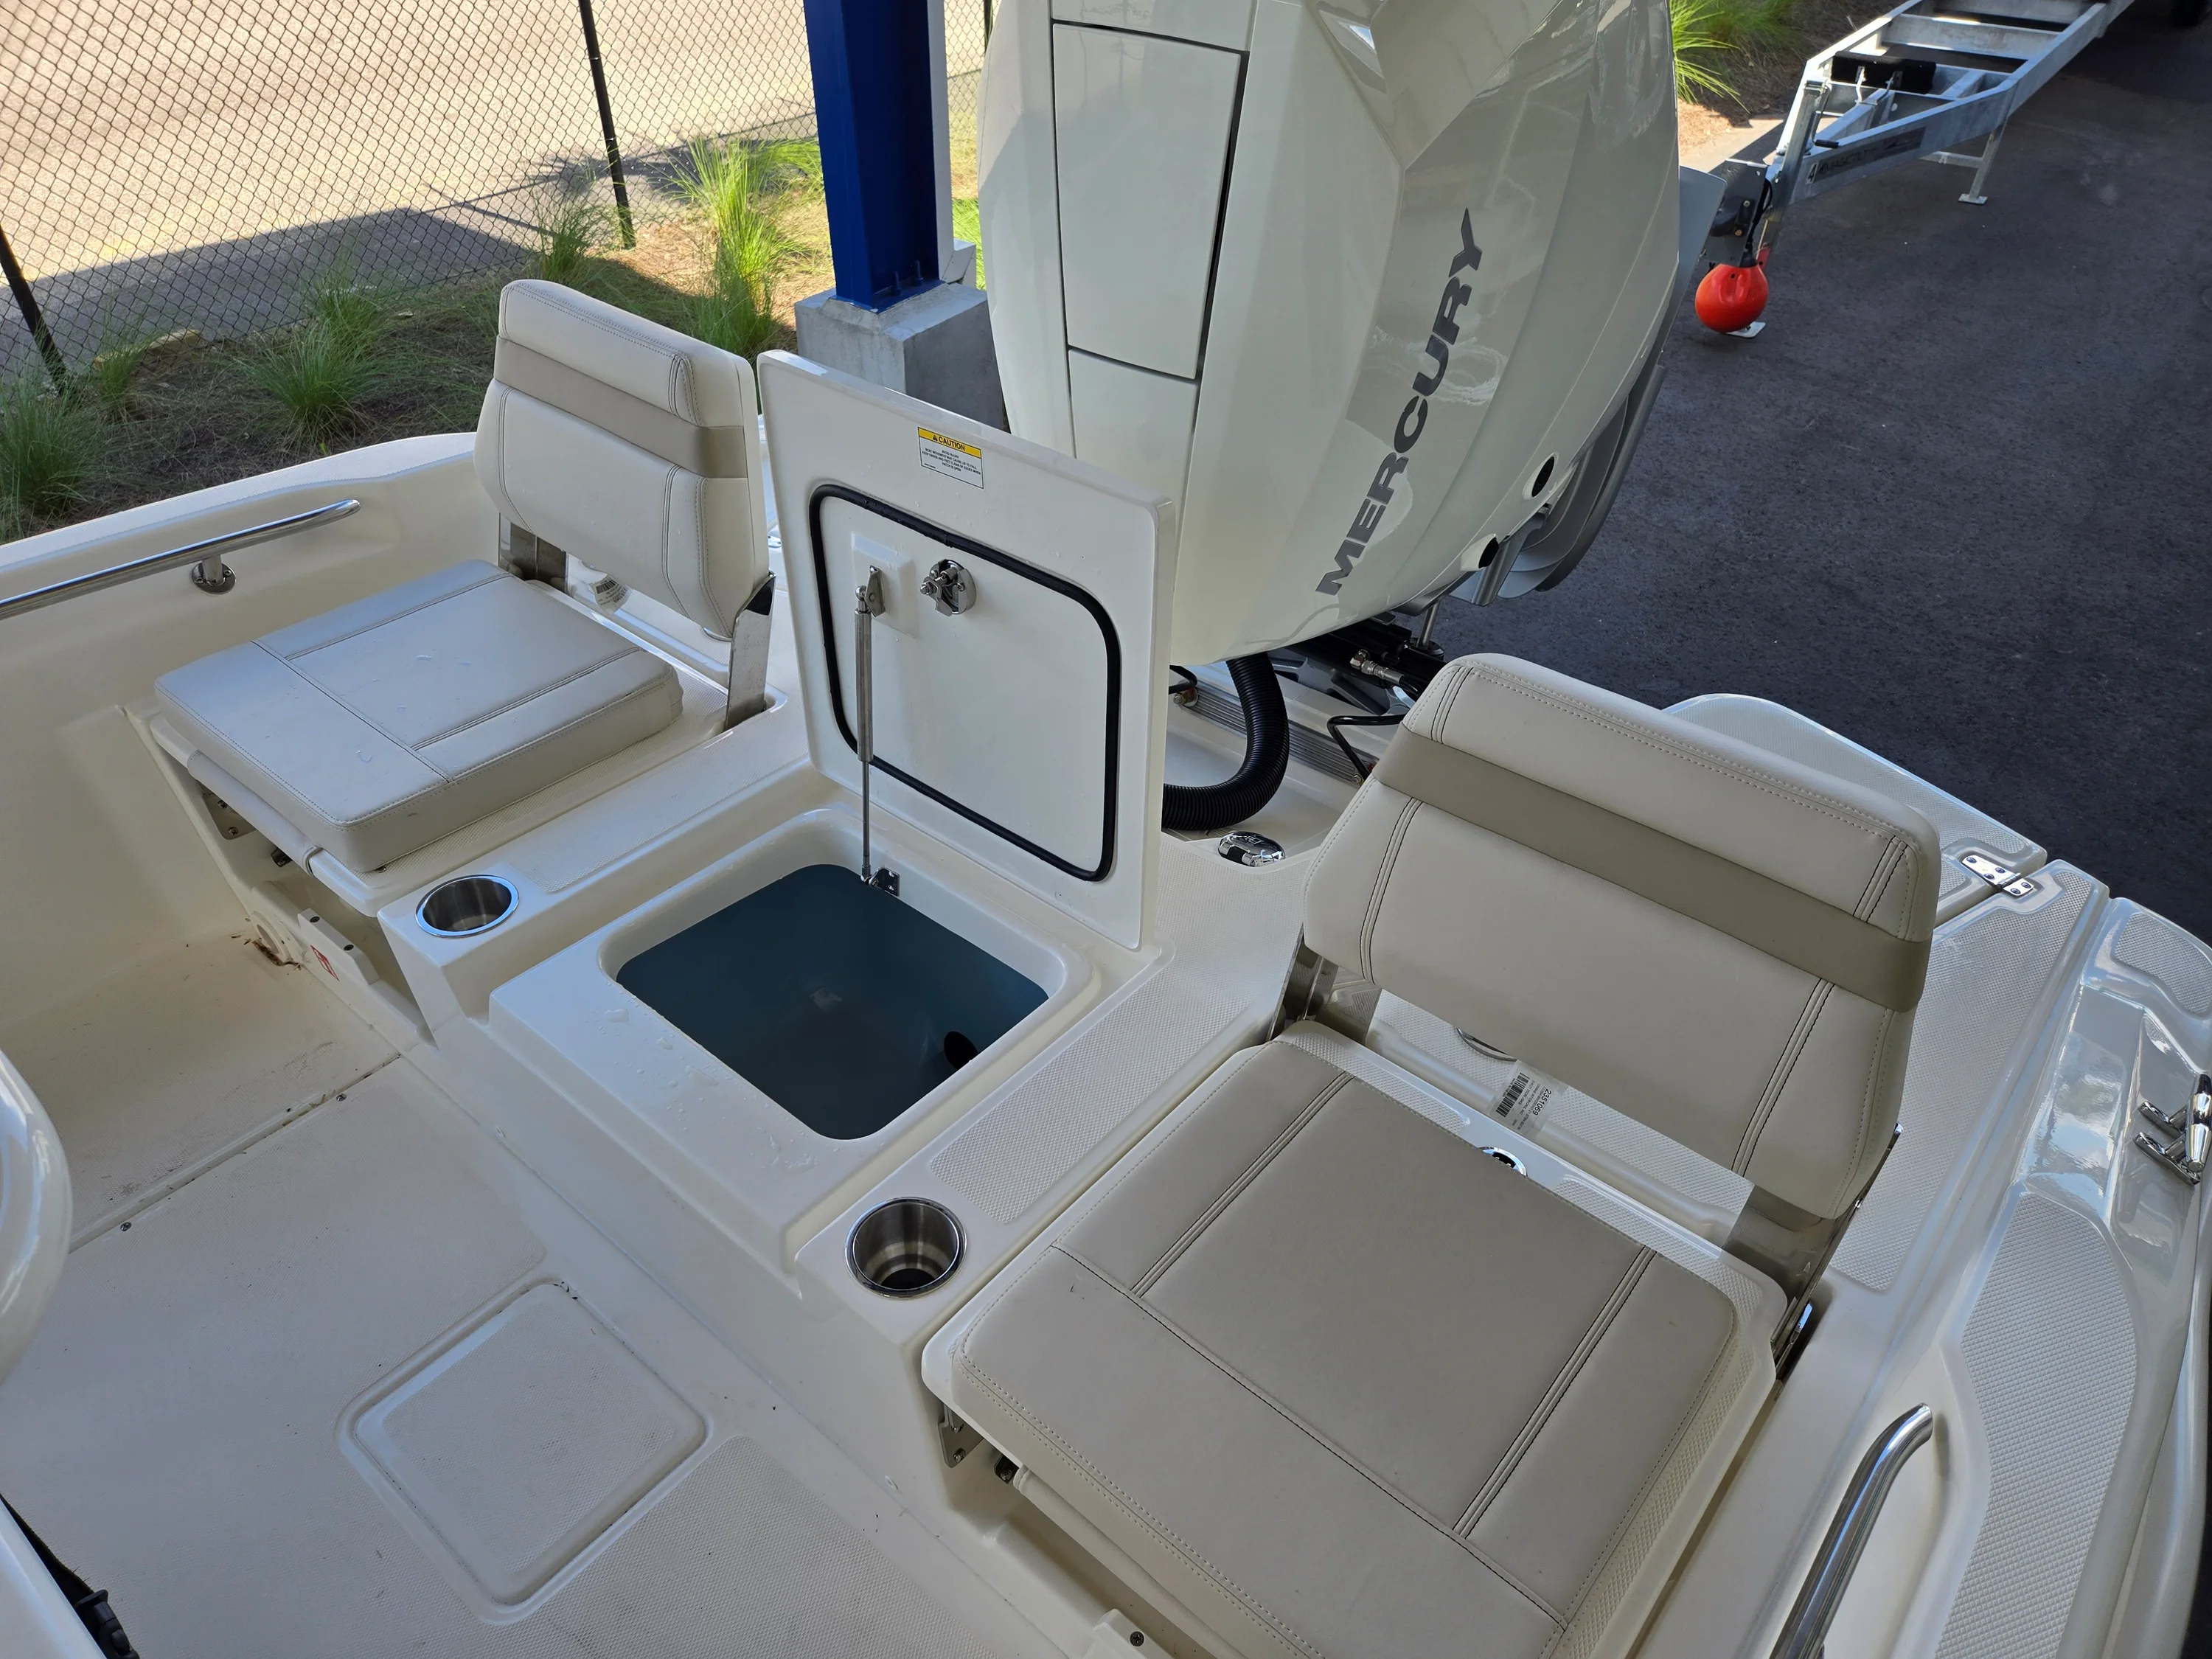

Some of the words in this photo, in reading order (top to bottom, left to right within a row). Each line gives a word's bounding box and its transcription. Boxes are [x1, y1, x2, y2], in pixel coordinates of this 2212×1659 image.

[1316, 207, 1483, 596] MERCURY
[939, 437, 965, 451] CAUTION
[1532, 1088, 1551, 1116] 2351069
